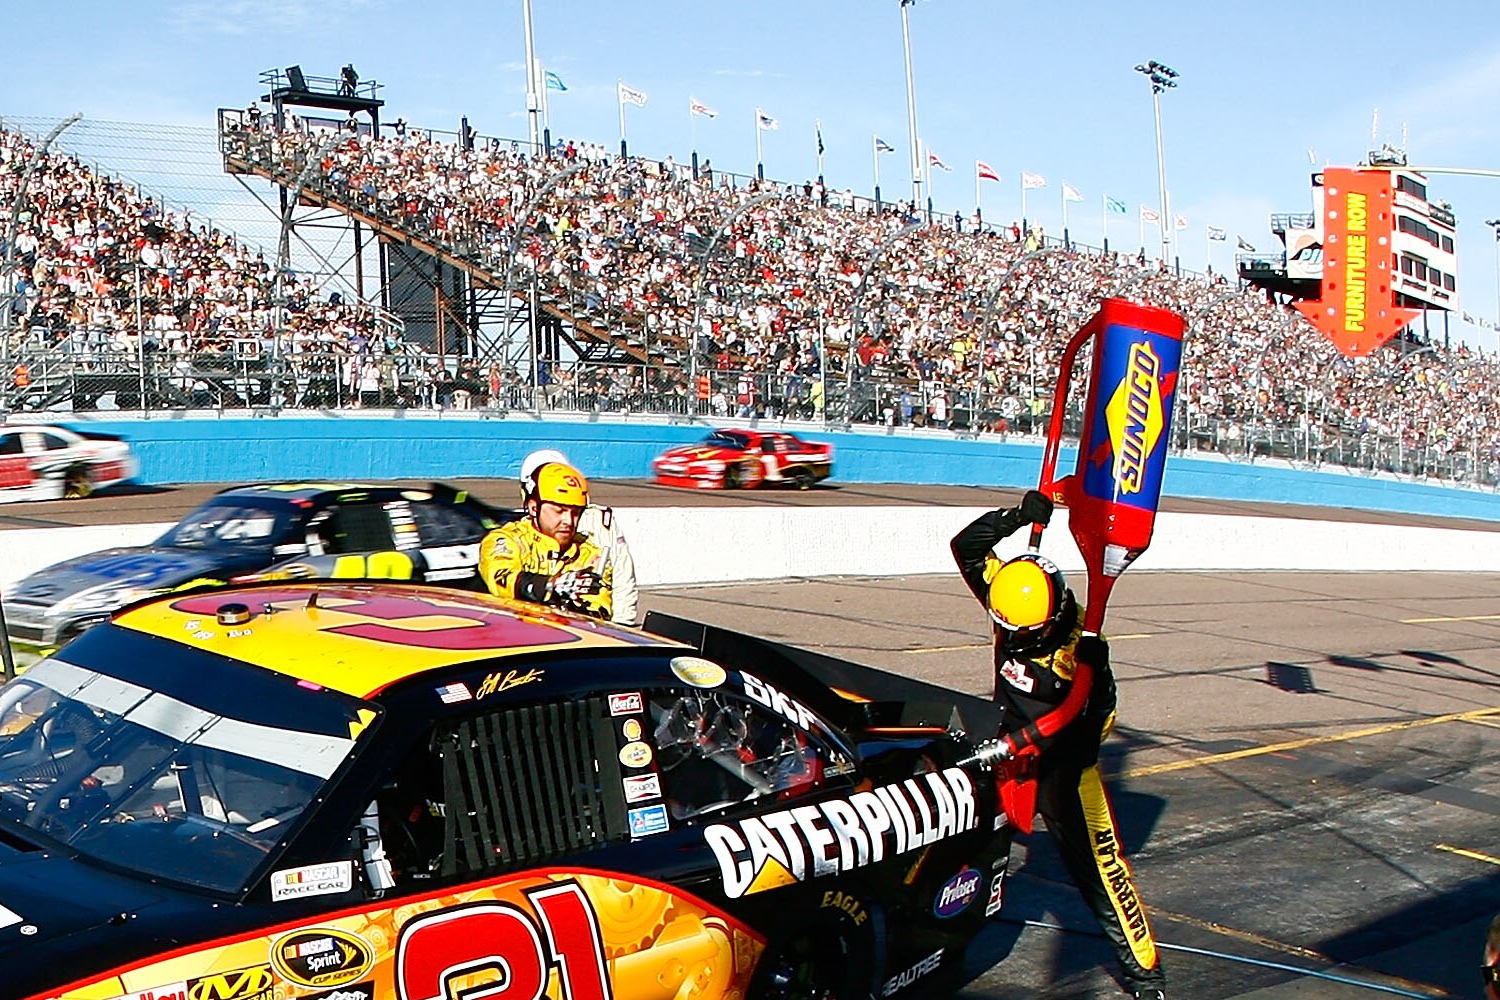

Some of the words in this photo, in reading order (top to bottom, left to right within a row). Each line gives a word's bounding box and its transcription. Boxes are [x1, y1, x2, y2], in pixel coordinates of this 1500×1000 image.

[1346, 193, 1367, 232] ROW
[1345, 235, 1367, 332] FURNITURE
[1119, 346, 1158, 494] SUNOCO
[703, 767, 976, 900] CATERPILLAR
[278, 883, 314, 896] RACE
[317, 880, 344, 891] CAR
[819, 889, 869, 927] EAGLE
[307, 950, 342, 972] Sprint
[313, 975, 333, 985] CUP
[334, 969, 362, 981] SERIES
